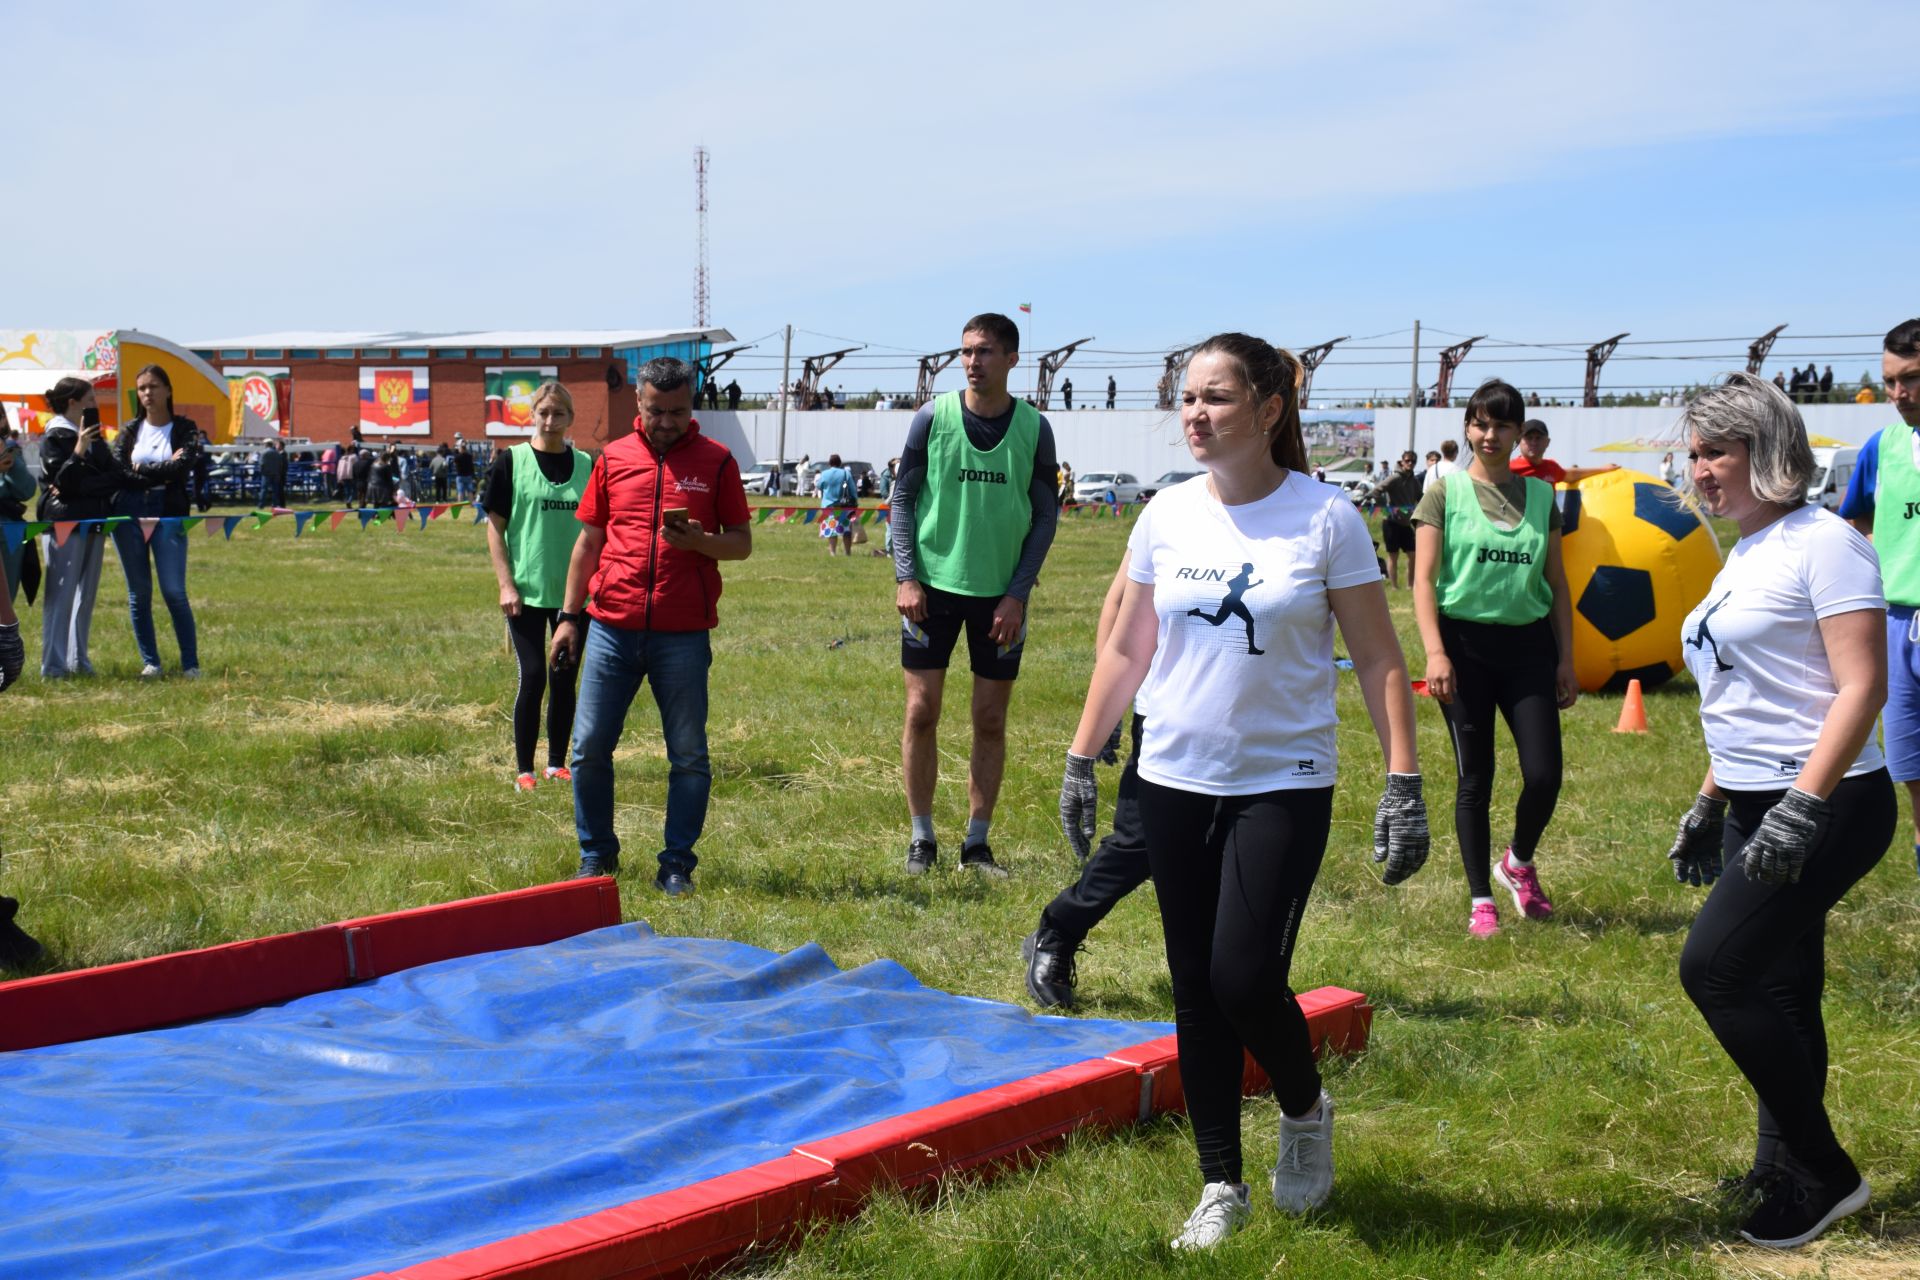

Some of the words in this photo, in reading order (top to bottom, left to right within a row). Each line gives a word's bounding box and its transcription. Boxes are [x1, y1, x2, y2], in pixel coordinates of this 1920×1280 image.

[958, 468, 1007, 484] Joma
[541, 499, 578, 511] Joma
[1477, 548, 1533, 565] Joma
[1175, 567, 1226, 581] RUN
[1280, 897, 1299, 956] NORDSKI
